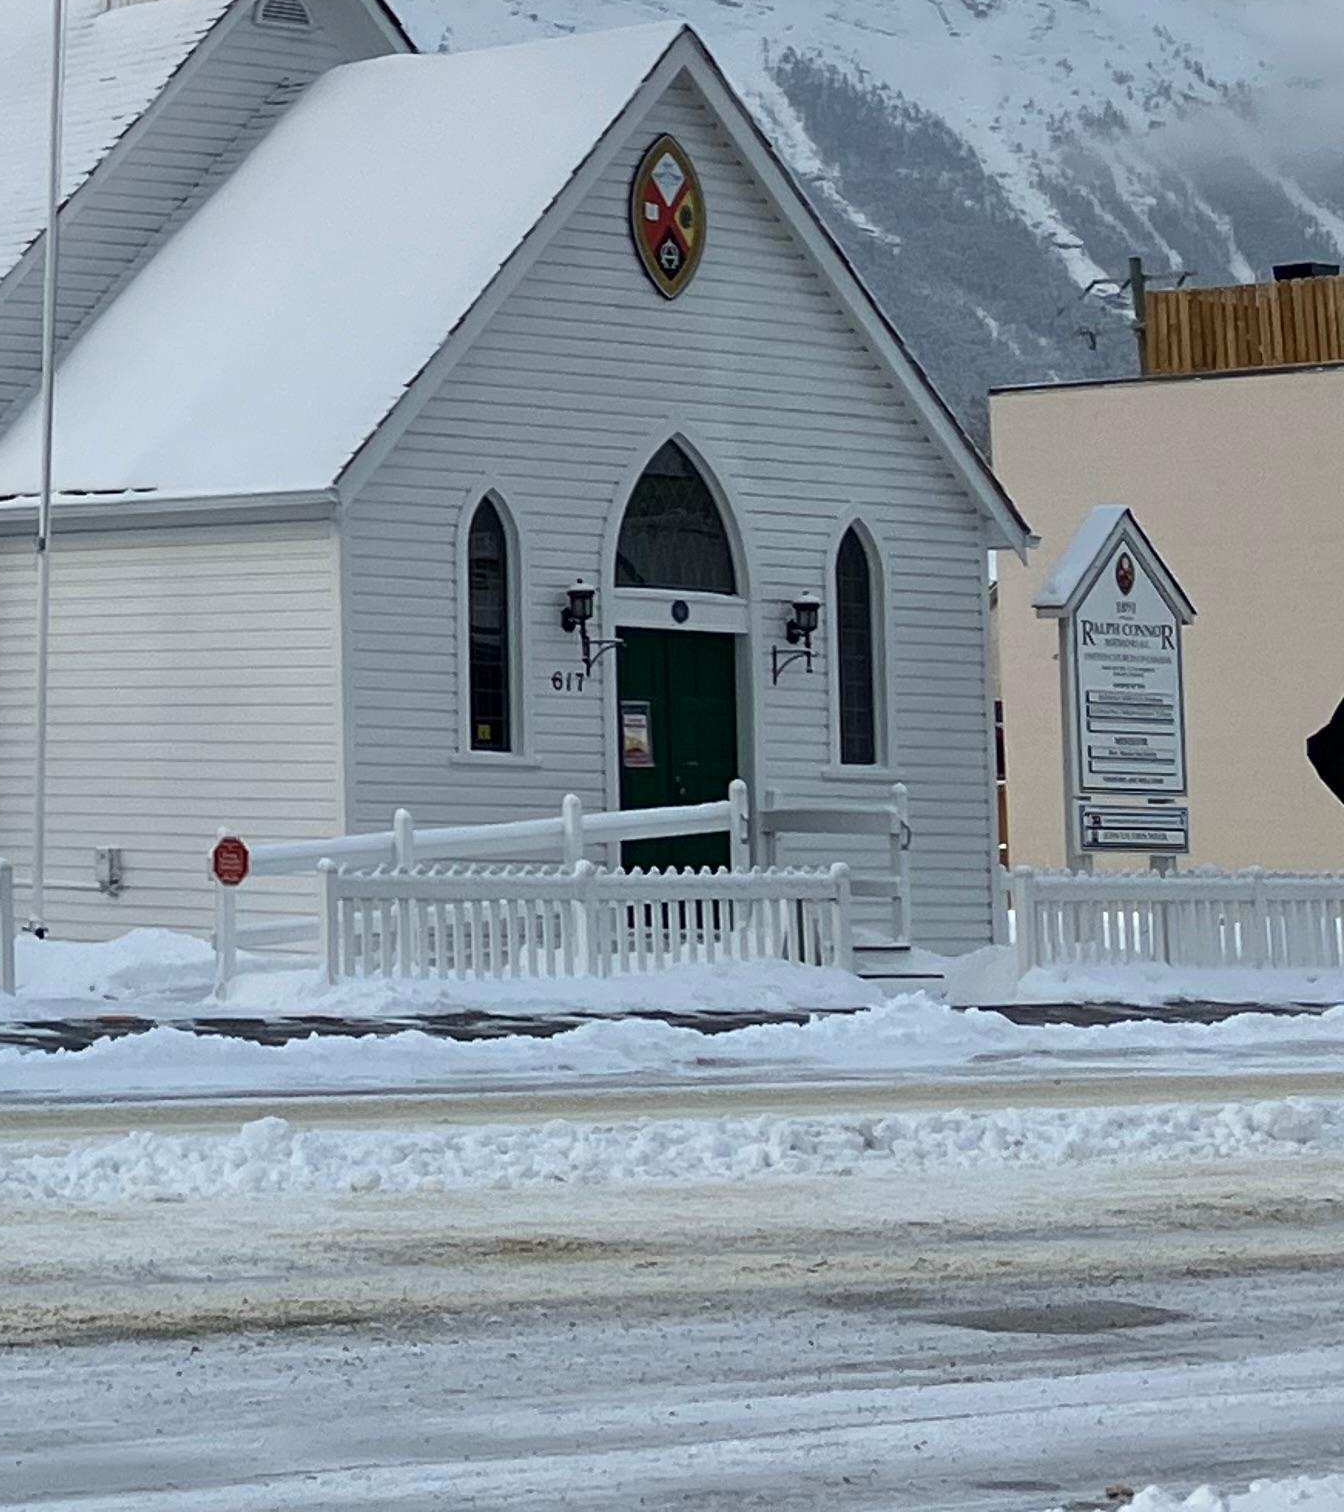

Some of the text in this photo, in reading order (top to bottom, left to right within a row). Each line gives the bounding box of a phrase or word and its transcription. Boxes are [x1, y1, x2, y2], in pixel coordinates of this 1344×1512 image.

[1080, 620, 1175, 650] RALPH CONNOR
[551, 671, 584, 692] 617
